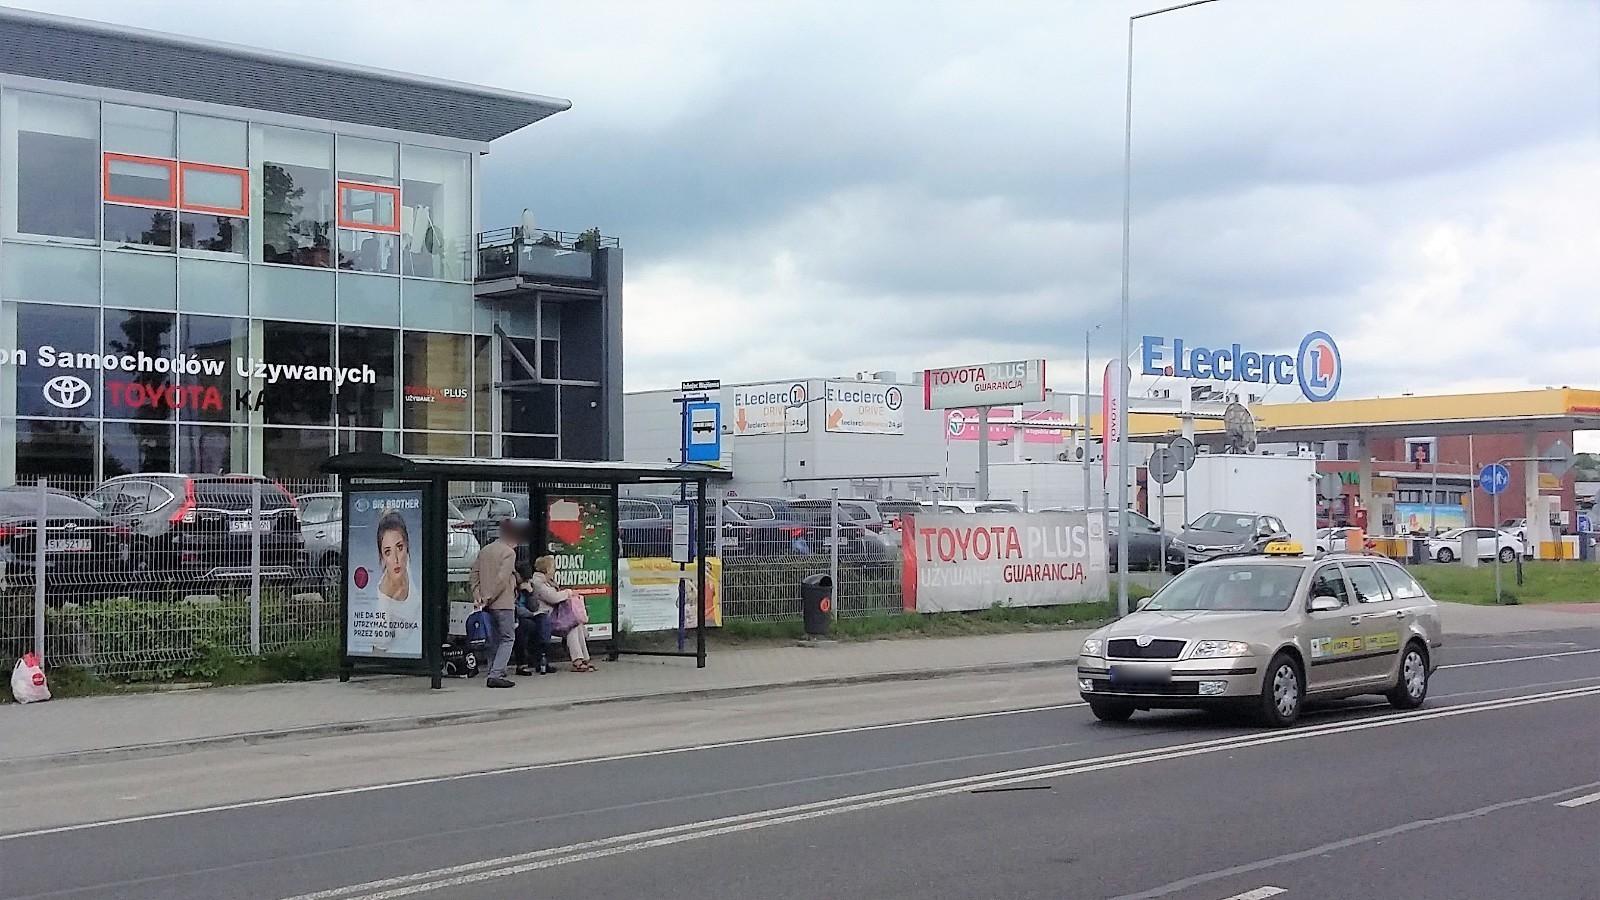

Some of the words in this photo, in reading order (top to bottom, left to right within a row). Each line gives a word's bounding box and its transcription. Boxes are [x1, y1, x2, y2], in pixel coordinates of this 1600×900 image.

[37, 345, 226, 376] Samochodów
[236, 356, 376, 386] Używanych
[1143, 335, 1293, 385] E.Leclerc
[932, 367, 986, 385] TOYOTA
[989, 362, 1025, 379] PLUS
[106, 380, 224, 410] TOYOTA
[444, 388, 468, 398] PLUS
[735, 391, 788, 406] E.Leclerc
[827, 388, 883, 405] E.Leclerc
[858, 405, 885, 416] DRIVE
[372, 499, 385, 509] BIG
[386, 498, 419, 509] BROTHER
[920, 526, 1023, 562] TOYOTA
[1027, 525, 1086, 559] PLUS
[374, 630, 383, 638] 90
